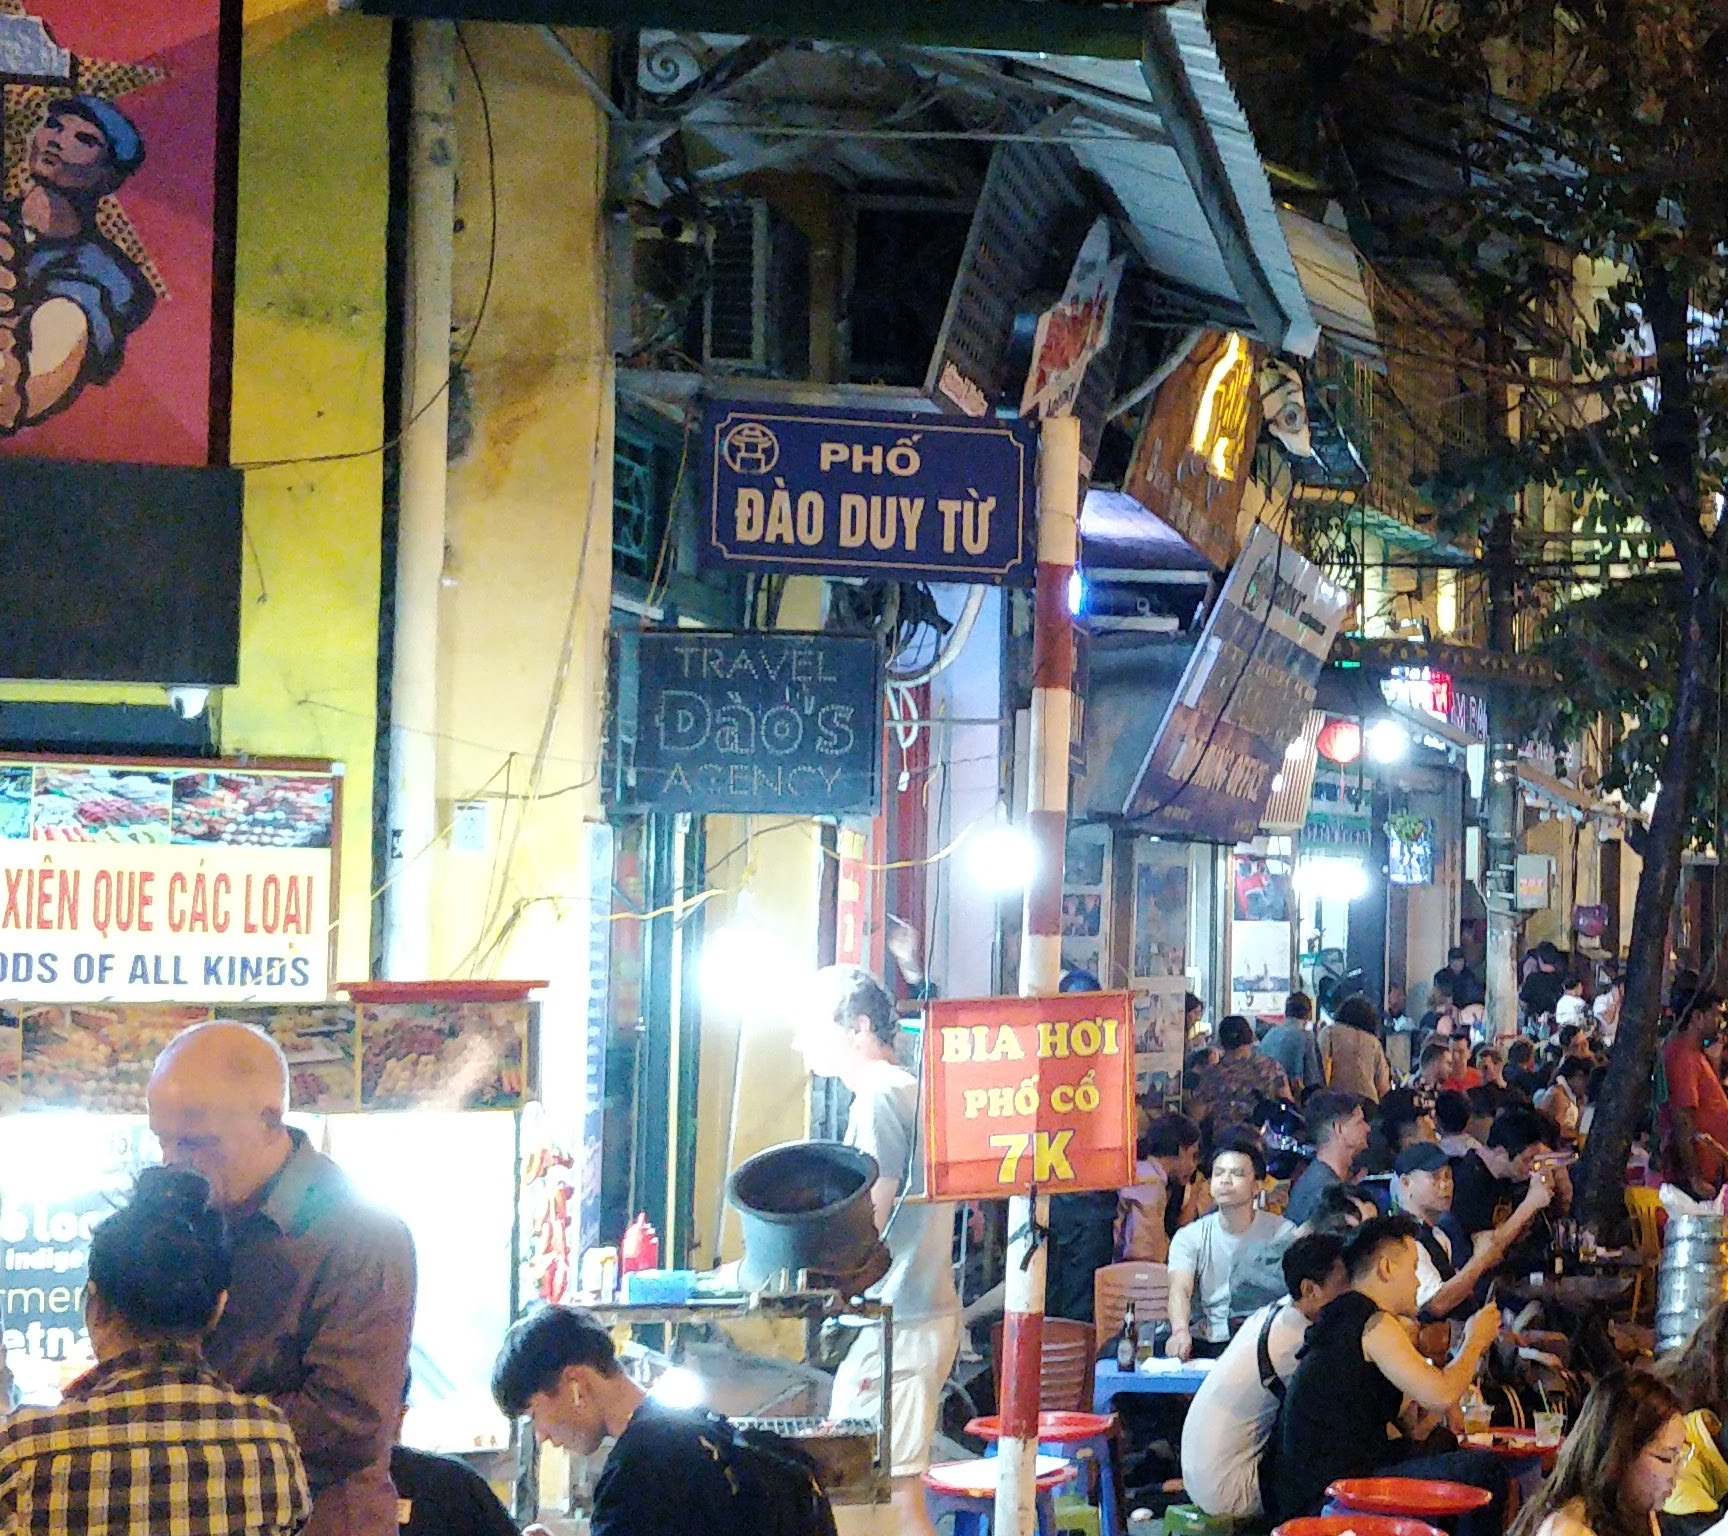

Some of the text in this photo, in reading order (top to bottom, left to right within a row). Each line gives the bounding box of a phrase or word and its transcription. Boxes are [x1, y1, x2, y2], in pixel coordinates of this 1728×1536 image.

[820, 433, 923, 476] PHỐ
[735, 476, 997, 555] ĐÀO DUY TỪ
[674, 646, 838, 683] TRAVEL
[662, 762, 843, 797] AGENCY
[2, 855, 80, 930] XIÊN
[93, 869, 155, 939] QUE
[168, 858, 231, 933] CÁC
[73, 953, 116, 984] OF
[128, 955, 189, 985] ALL
[203, 955, 310, 987] KINDS
[940, 1016, 1119, 1063] BIA HƠI
[963, 1074, 1040, 1119] PHỐ
[988, 1129, 1076, 1183] 7K
